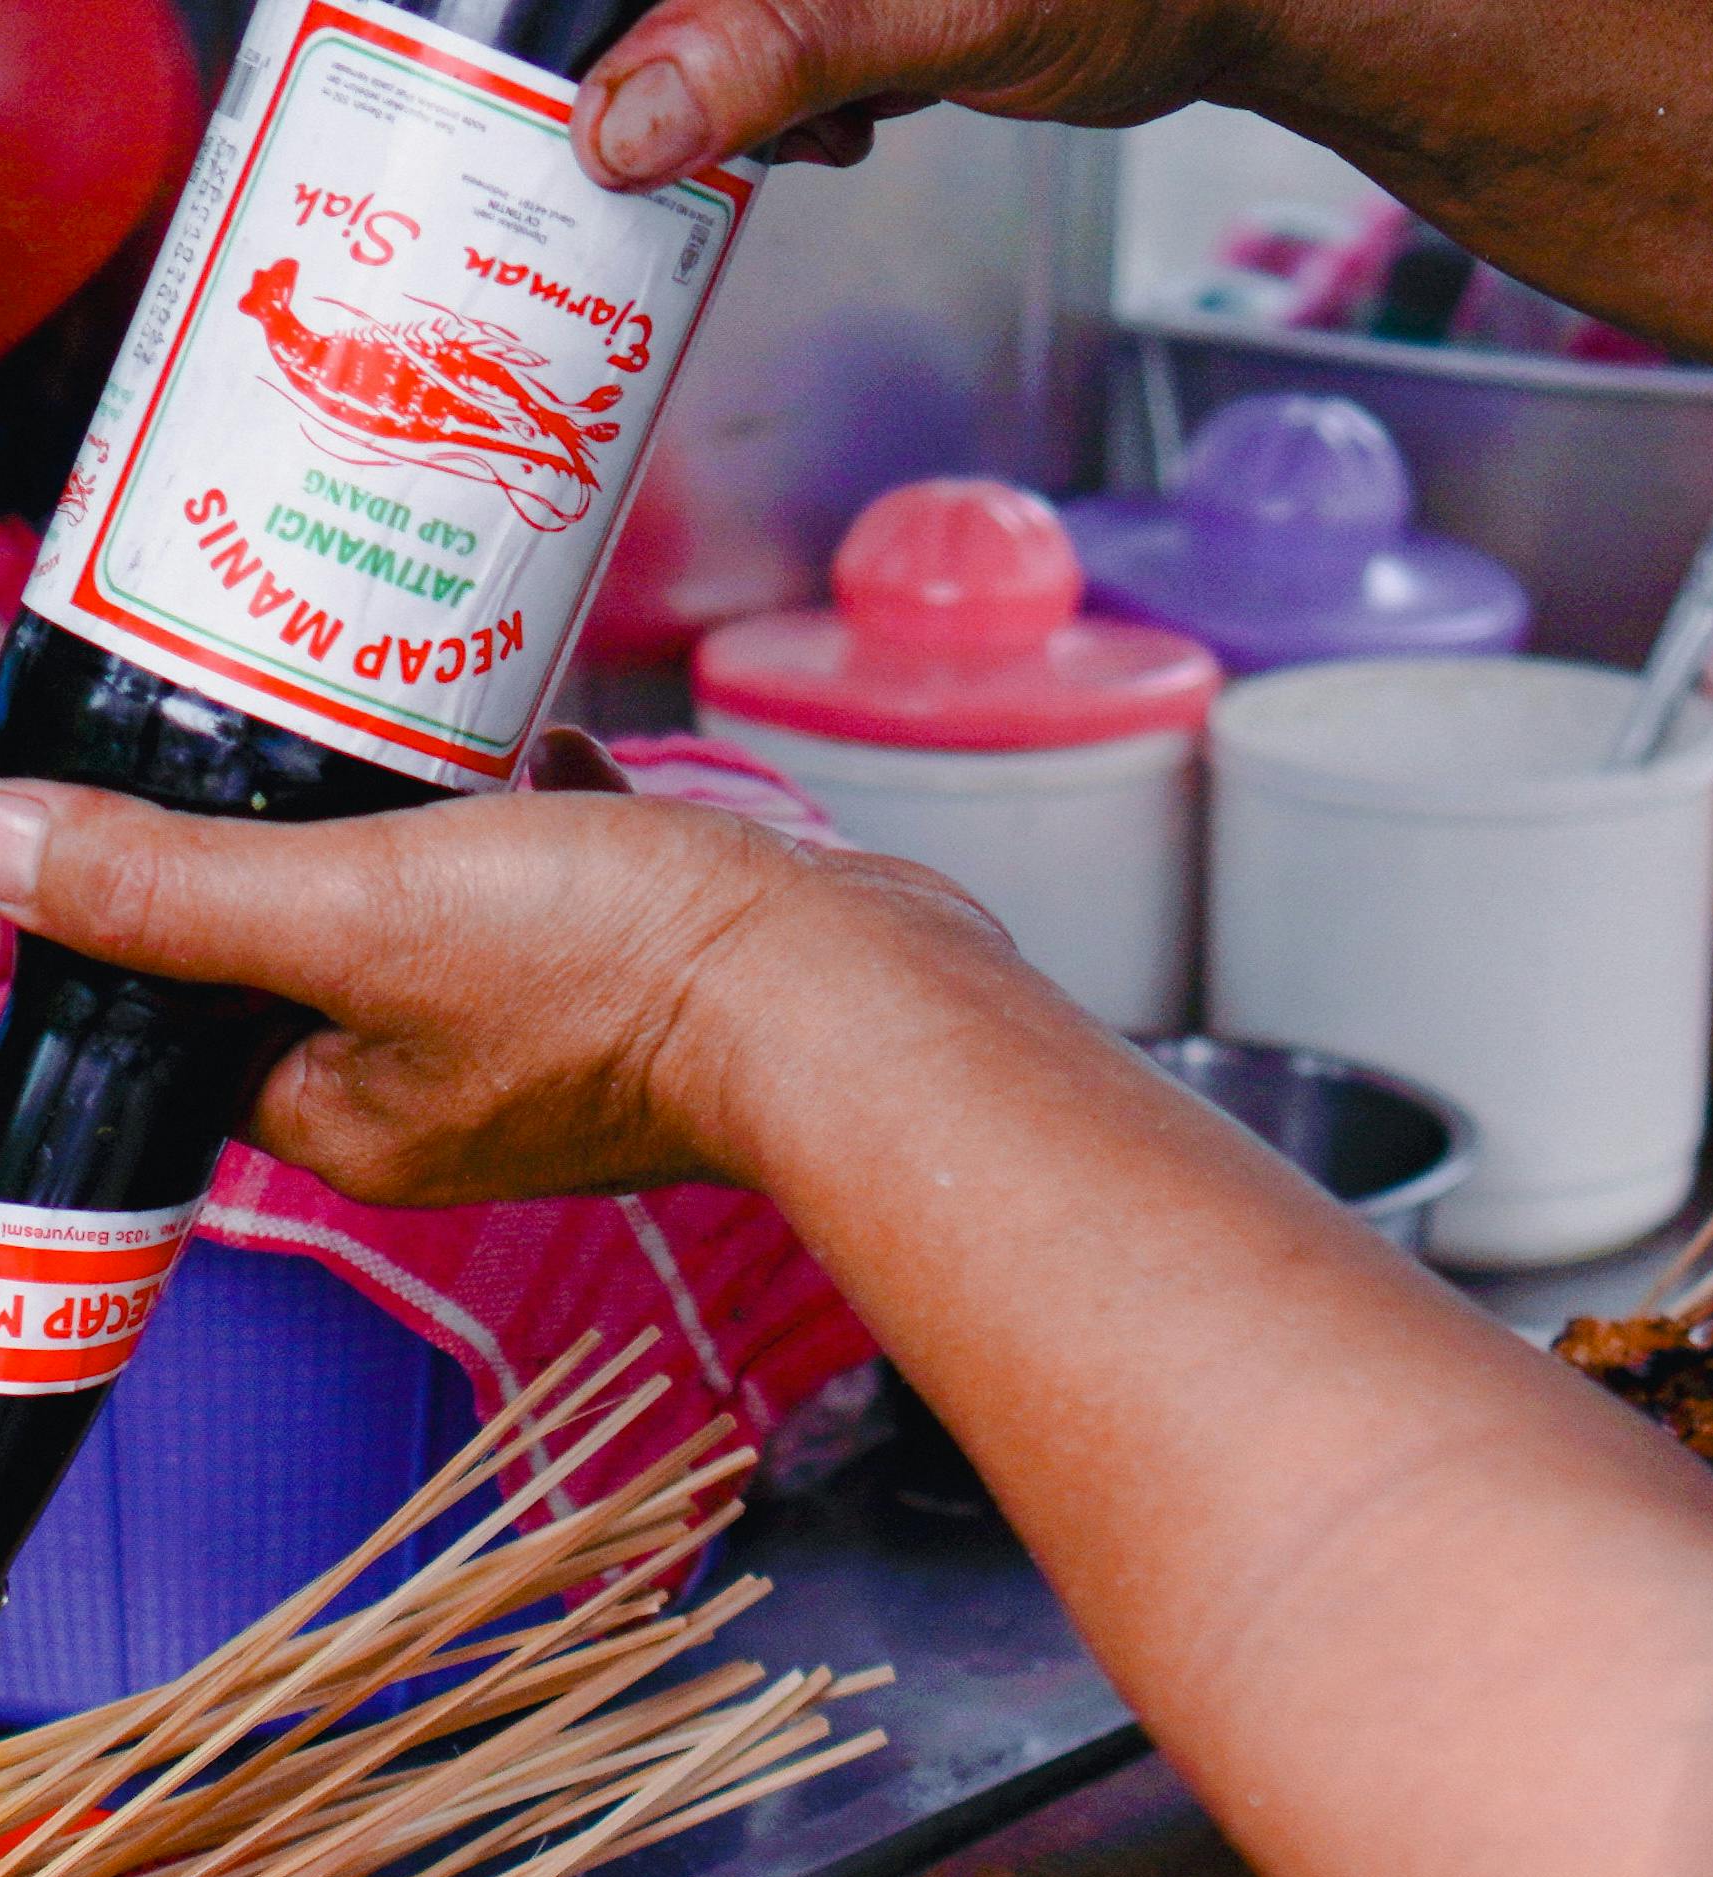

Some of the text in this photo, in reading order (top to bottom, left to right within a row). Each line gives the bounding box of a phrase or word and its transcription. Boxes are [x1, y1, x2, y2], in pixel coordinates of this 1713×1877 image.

[264, 504, 475, 608] JATIWANGI
[303, 469, 477, 556] CAP UDANG
[183, 487, 523, 684] KECAP MANIS
[1, 1223, 109, 1245] Banyuresmi
